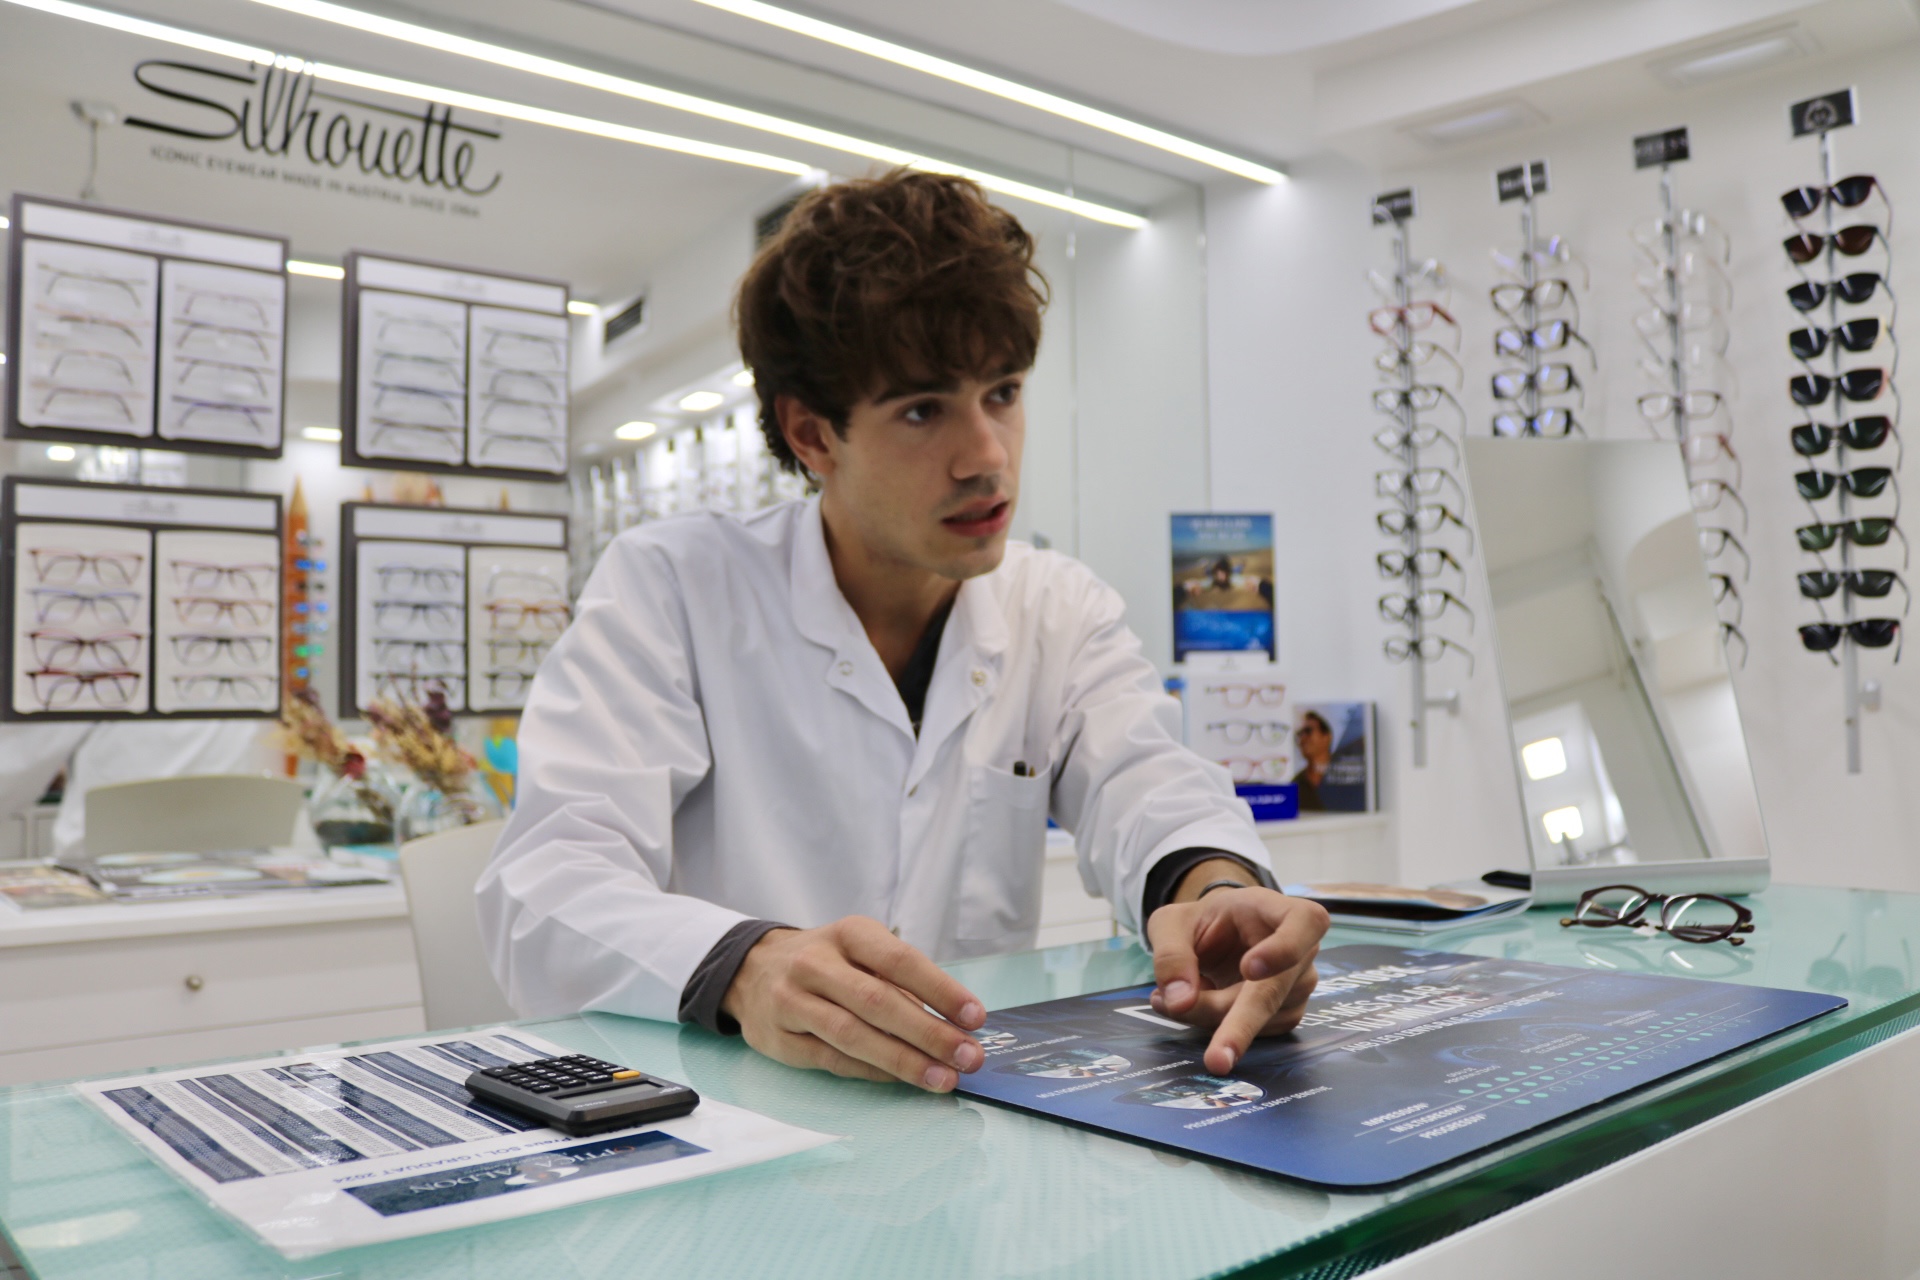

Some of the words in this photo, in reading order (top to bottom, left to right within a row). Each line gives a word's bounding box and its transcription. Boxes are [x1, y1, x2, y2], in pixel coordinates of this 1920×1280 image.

[124, 57, 502, 196] Silhouette
[332, 1170, 377, 1184] 2024
[382, 1156, 477, 1176] GRADUAT
[409, 1165, 534, 1194] ALDON
